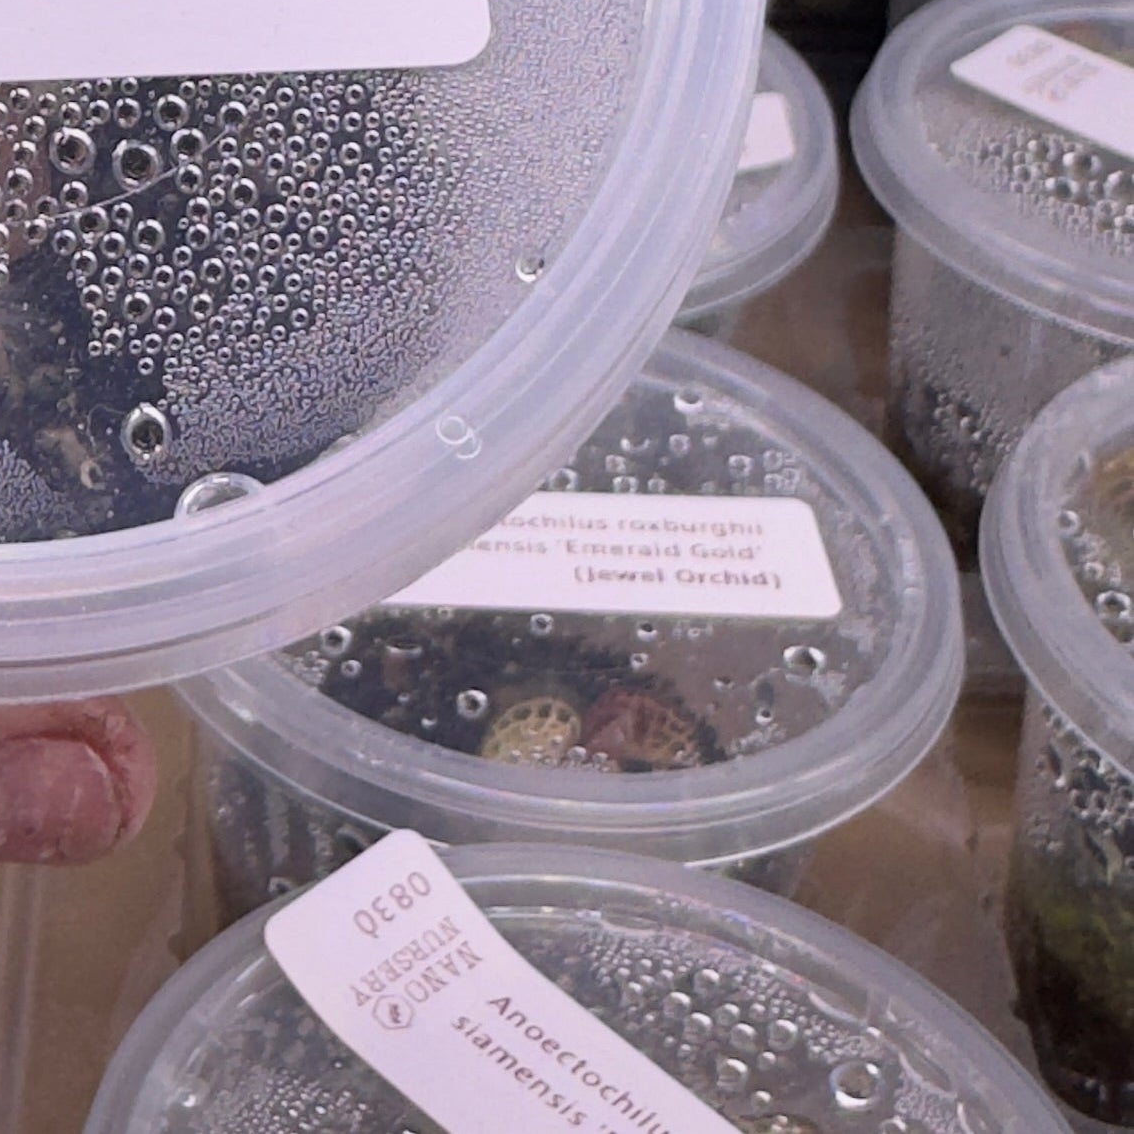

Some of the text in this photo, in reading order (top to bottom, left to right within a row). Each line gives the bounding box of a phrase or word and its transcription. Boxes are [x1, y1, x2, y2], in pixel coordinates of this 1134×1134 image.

[675, 568, 781, 589] Orchid)
[353, 871, 431, 939] 0830
[350, 915, 462, 1007] NURSERY
[404, 940, 484, 1003] NANO
[451, 1015, 588, 1126] siamensis
